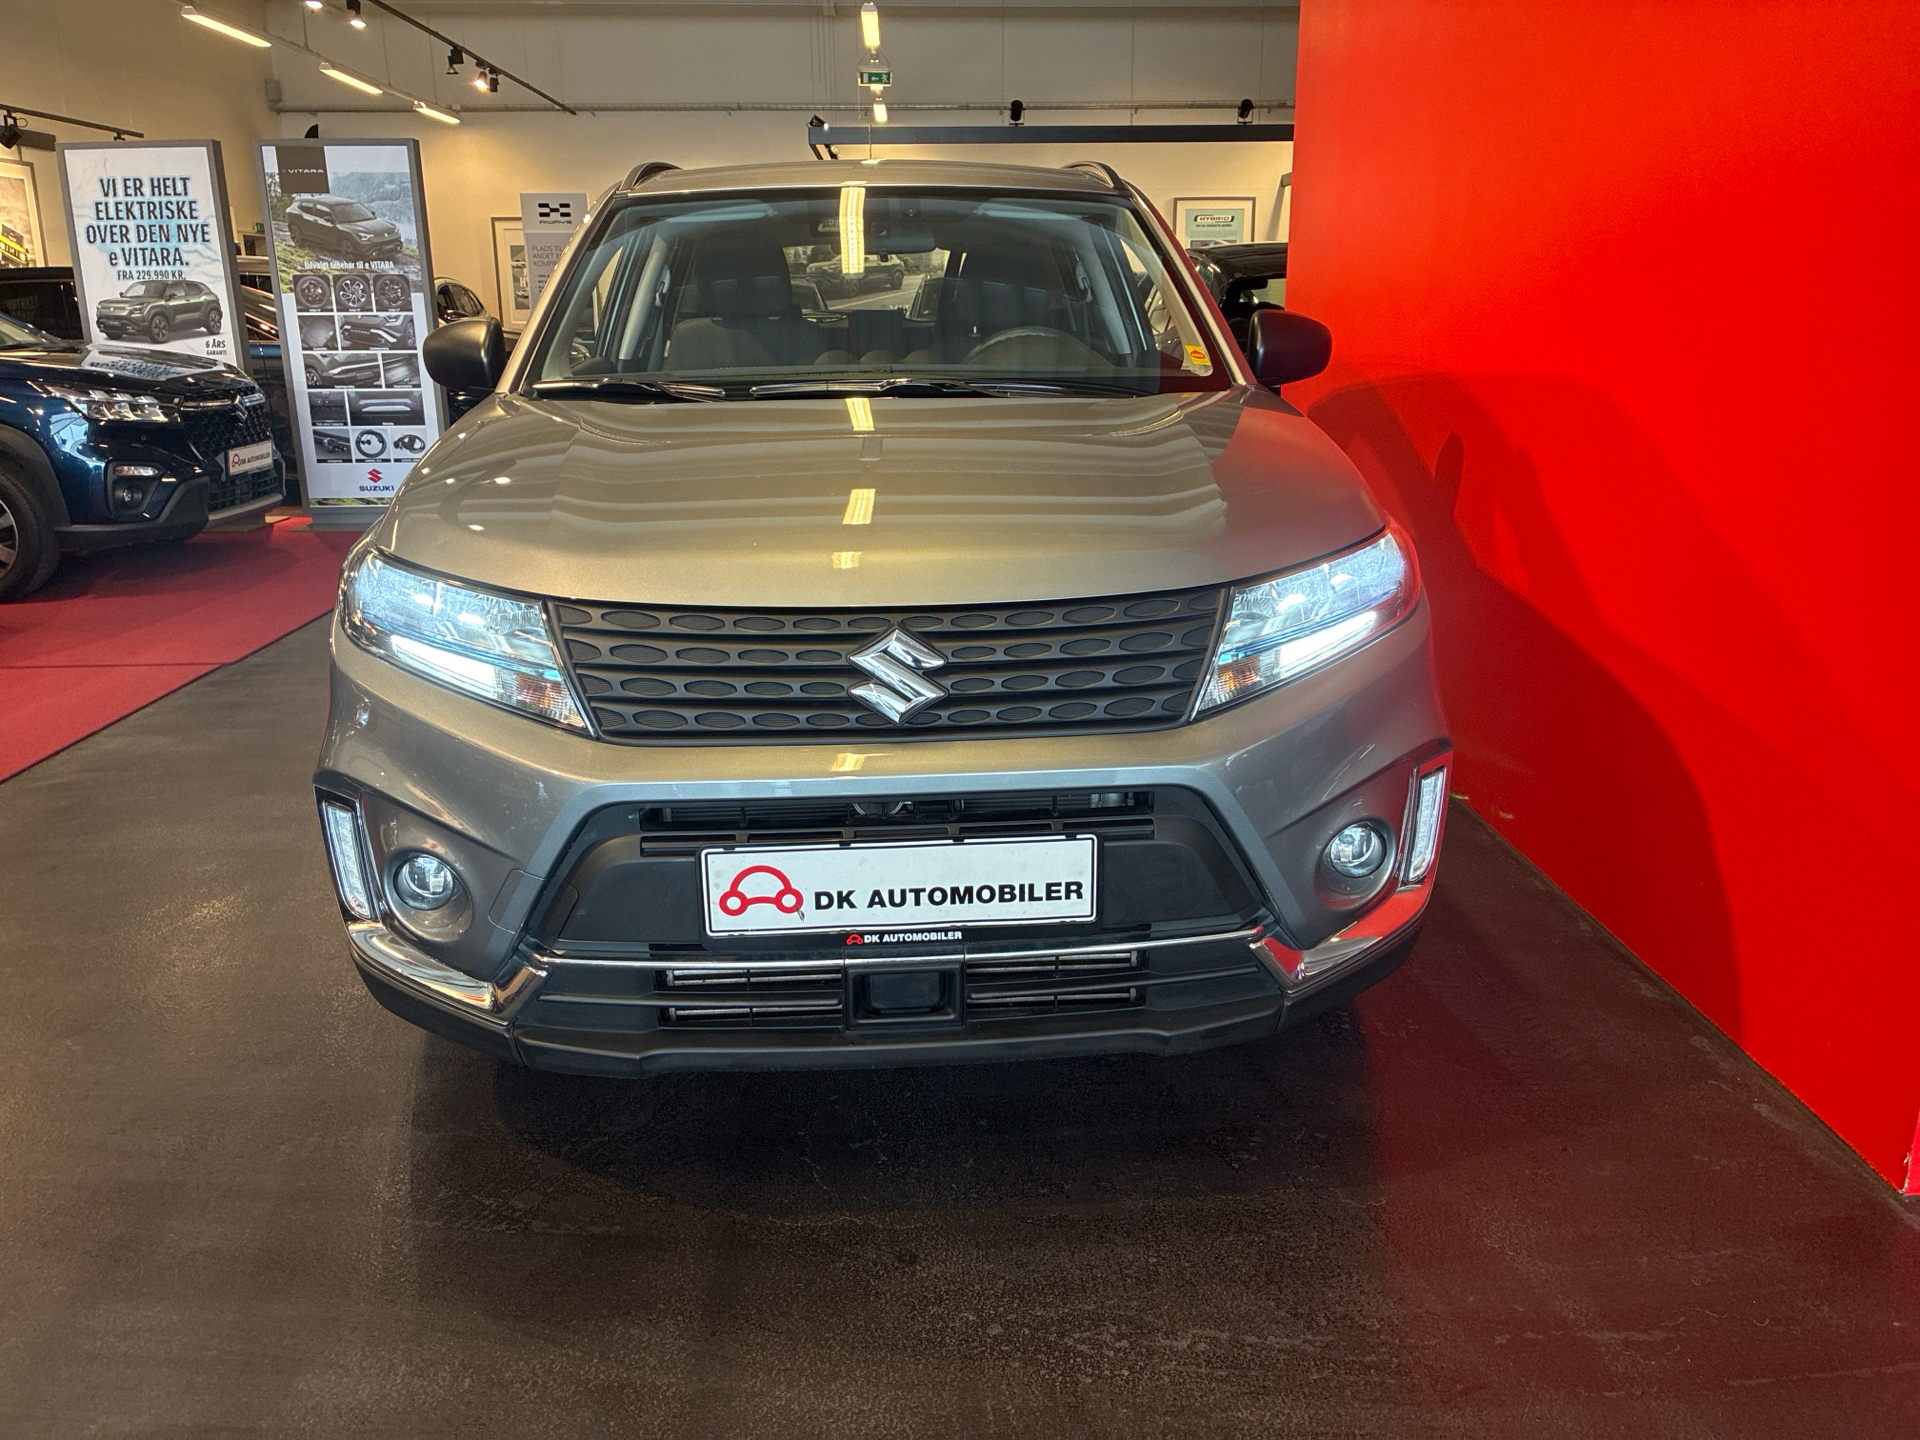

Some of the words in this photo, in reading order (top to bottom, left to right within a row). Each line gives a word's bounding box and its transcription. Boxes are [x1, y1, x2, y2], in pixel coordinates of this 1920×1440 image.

[99, 177, 118, 197] VI
[124, 177, 145, 197] ER
[150, 177, 190, 197] HELT
[95, 200, 198, 221] ELEKTRISKE
[86, 224, 131, 244] OVER
[136, 224, 170, 243] DEN
[177, 223, 211, 243] NYE
[109, 251, 118, 267] e
[122, 247, 190, 267] VITARA.
[532, 252, 554, 260] ANDET
[304, 260, 329, 271] Udvalgt
[356, 260, 364, 270] til
[370, 260, 395, 270] VITARA
[117, 270, 134, 281] FRA
[136, 270, 170, 280] 229.990
[171, 270, 187, 281] KR.
[205, 340, 210, 349] 6
[814, 889, 858, 910] DK
[866, 880, 1085, 909] AUTOMOBILER
[863, 934, 881, 944] DK
[882, 931, 963, 943] AUTOMOBILER
